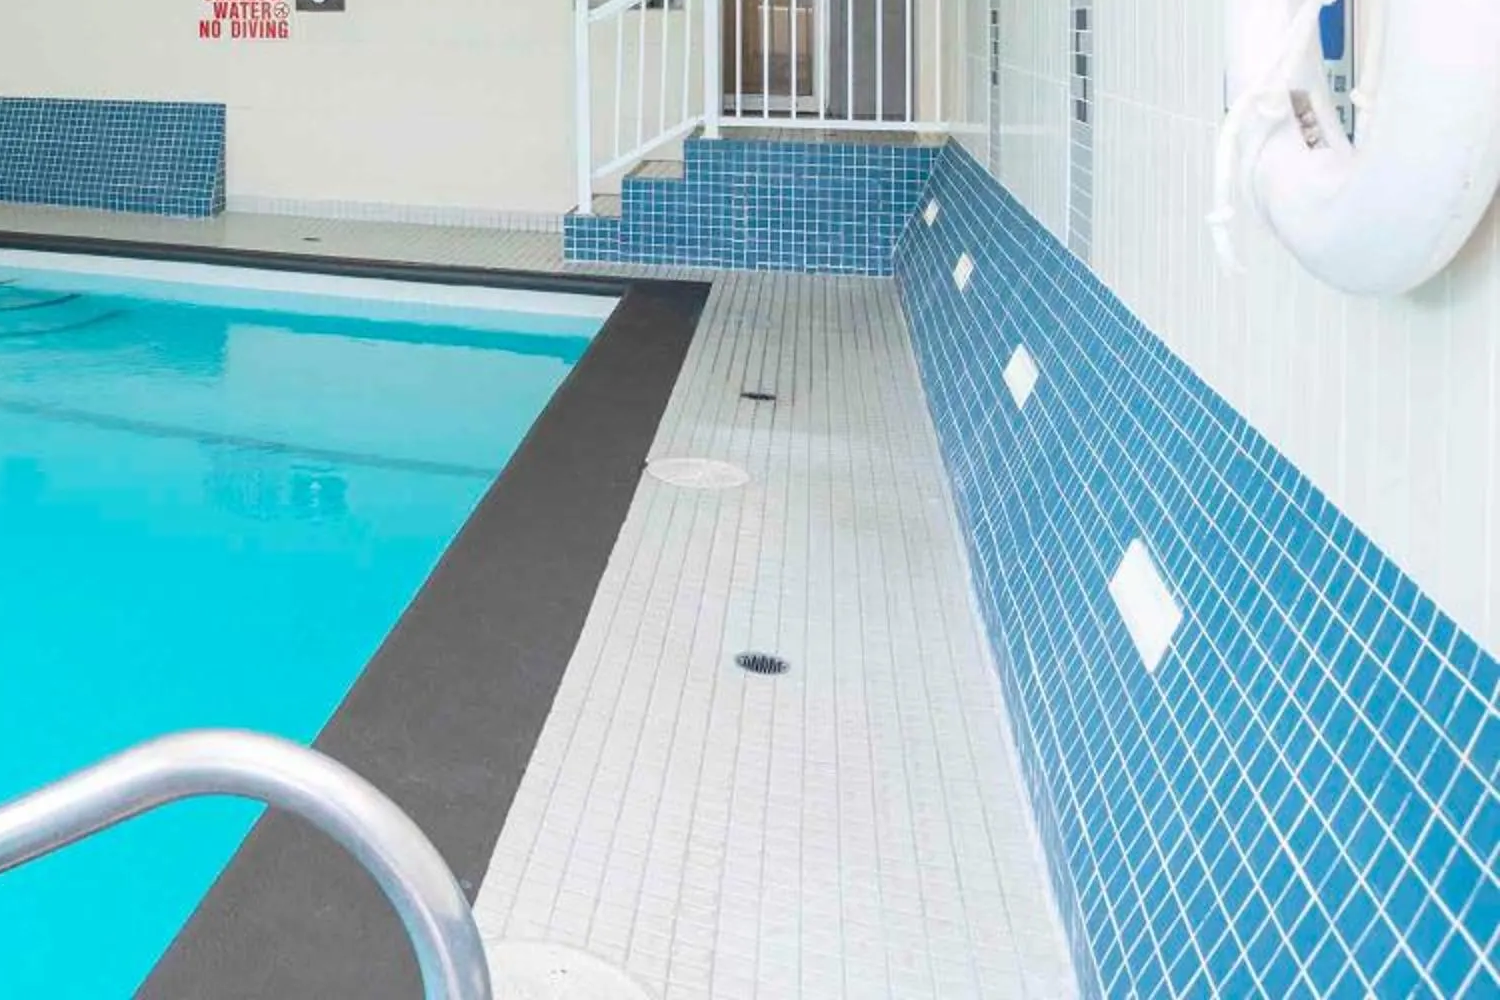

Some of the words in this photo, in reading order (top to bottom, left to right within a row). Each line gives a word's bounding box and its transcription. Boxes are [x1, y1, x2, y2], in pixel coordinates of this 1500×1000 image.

[213, 1, 271, 19] WATER
[199, 20, 221, 38] NO
[231, 20, 289, 38] DIVING
